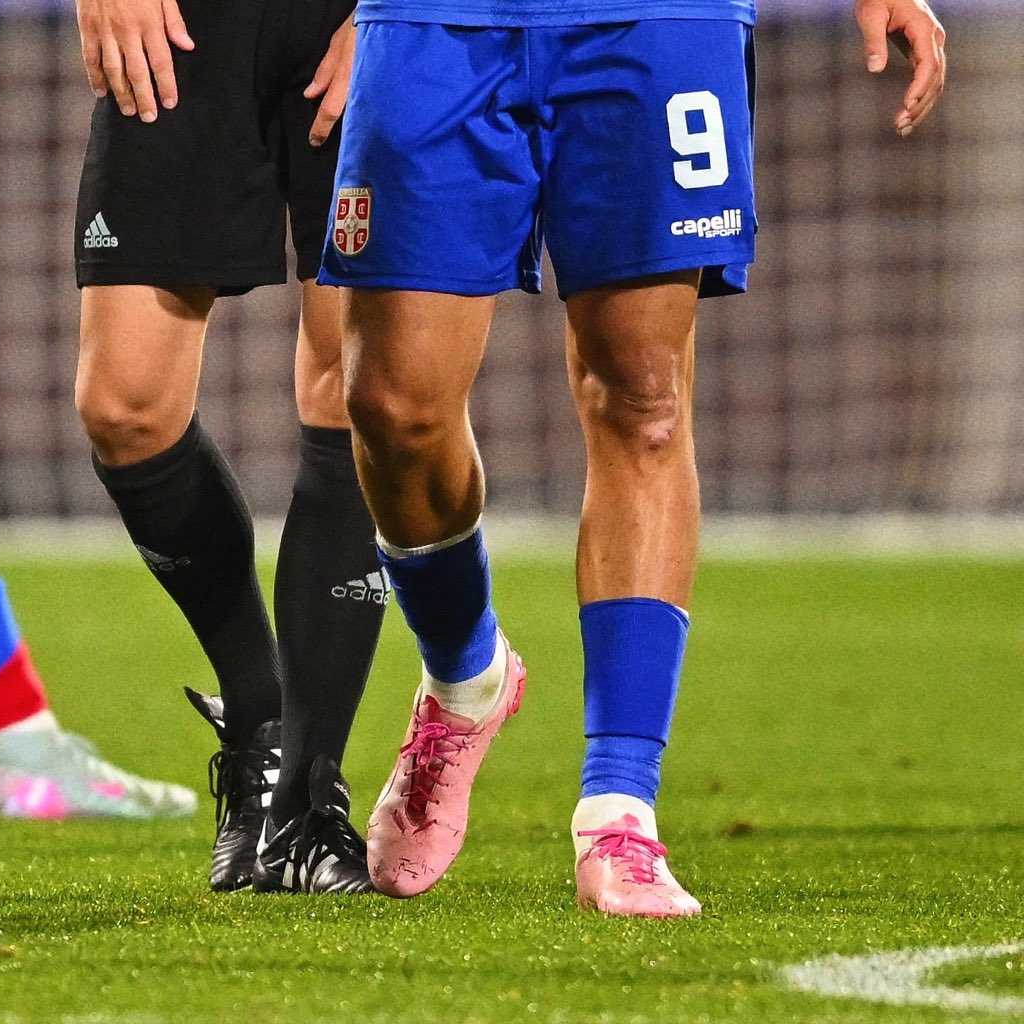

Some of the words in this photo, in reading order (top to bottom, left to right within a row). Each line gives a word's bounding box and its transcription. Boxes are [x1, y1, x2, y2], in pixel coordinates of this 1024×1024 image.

[666, 90, 730, 190] 9
[670, 208, 742, 238] capelli
[705, 228, 742, 239] SPORT
[83, 234, 119, 249] adidas
